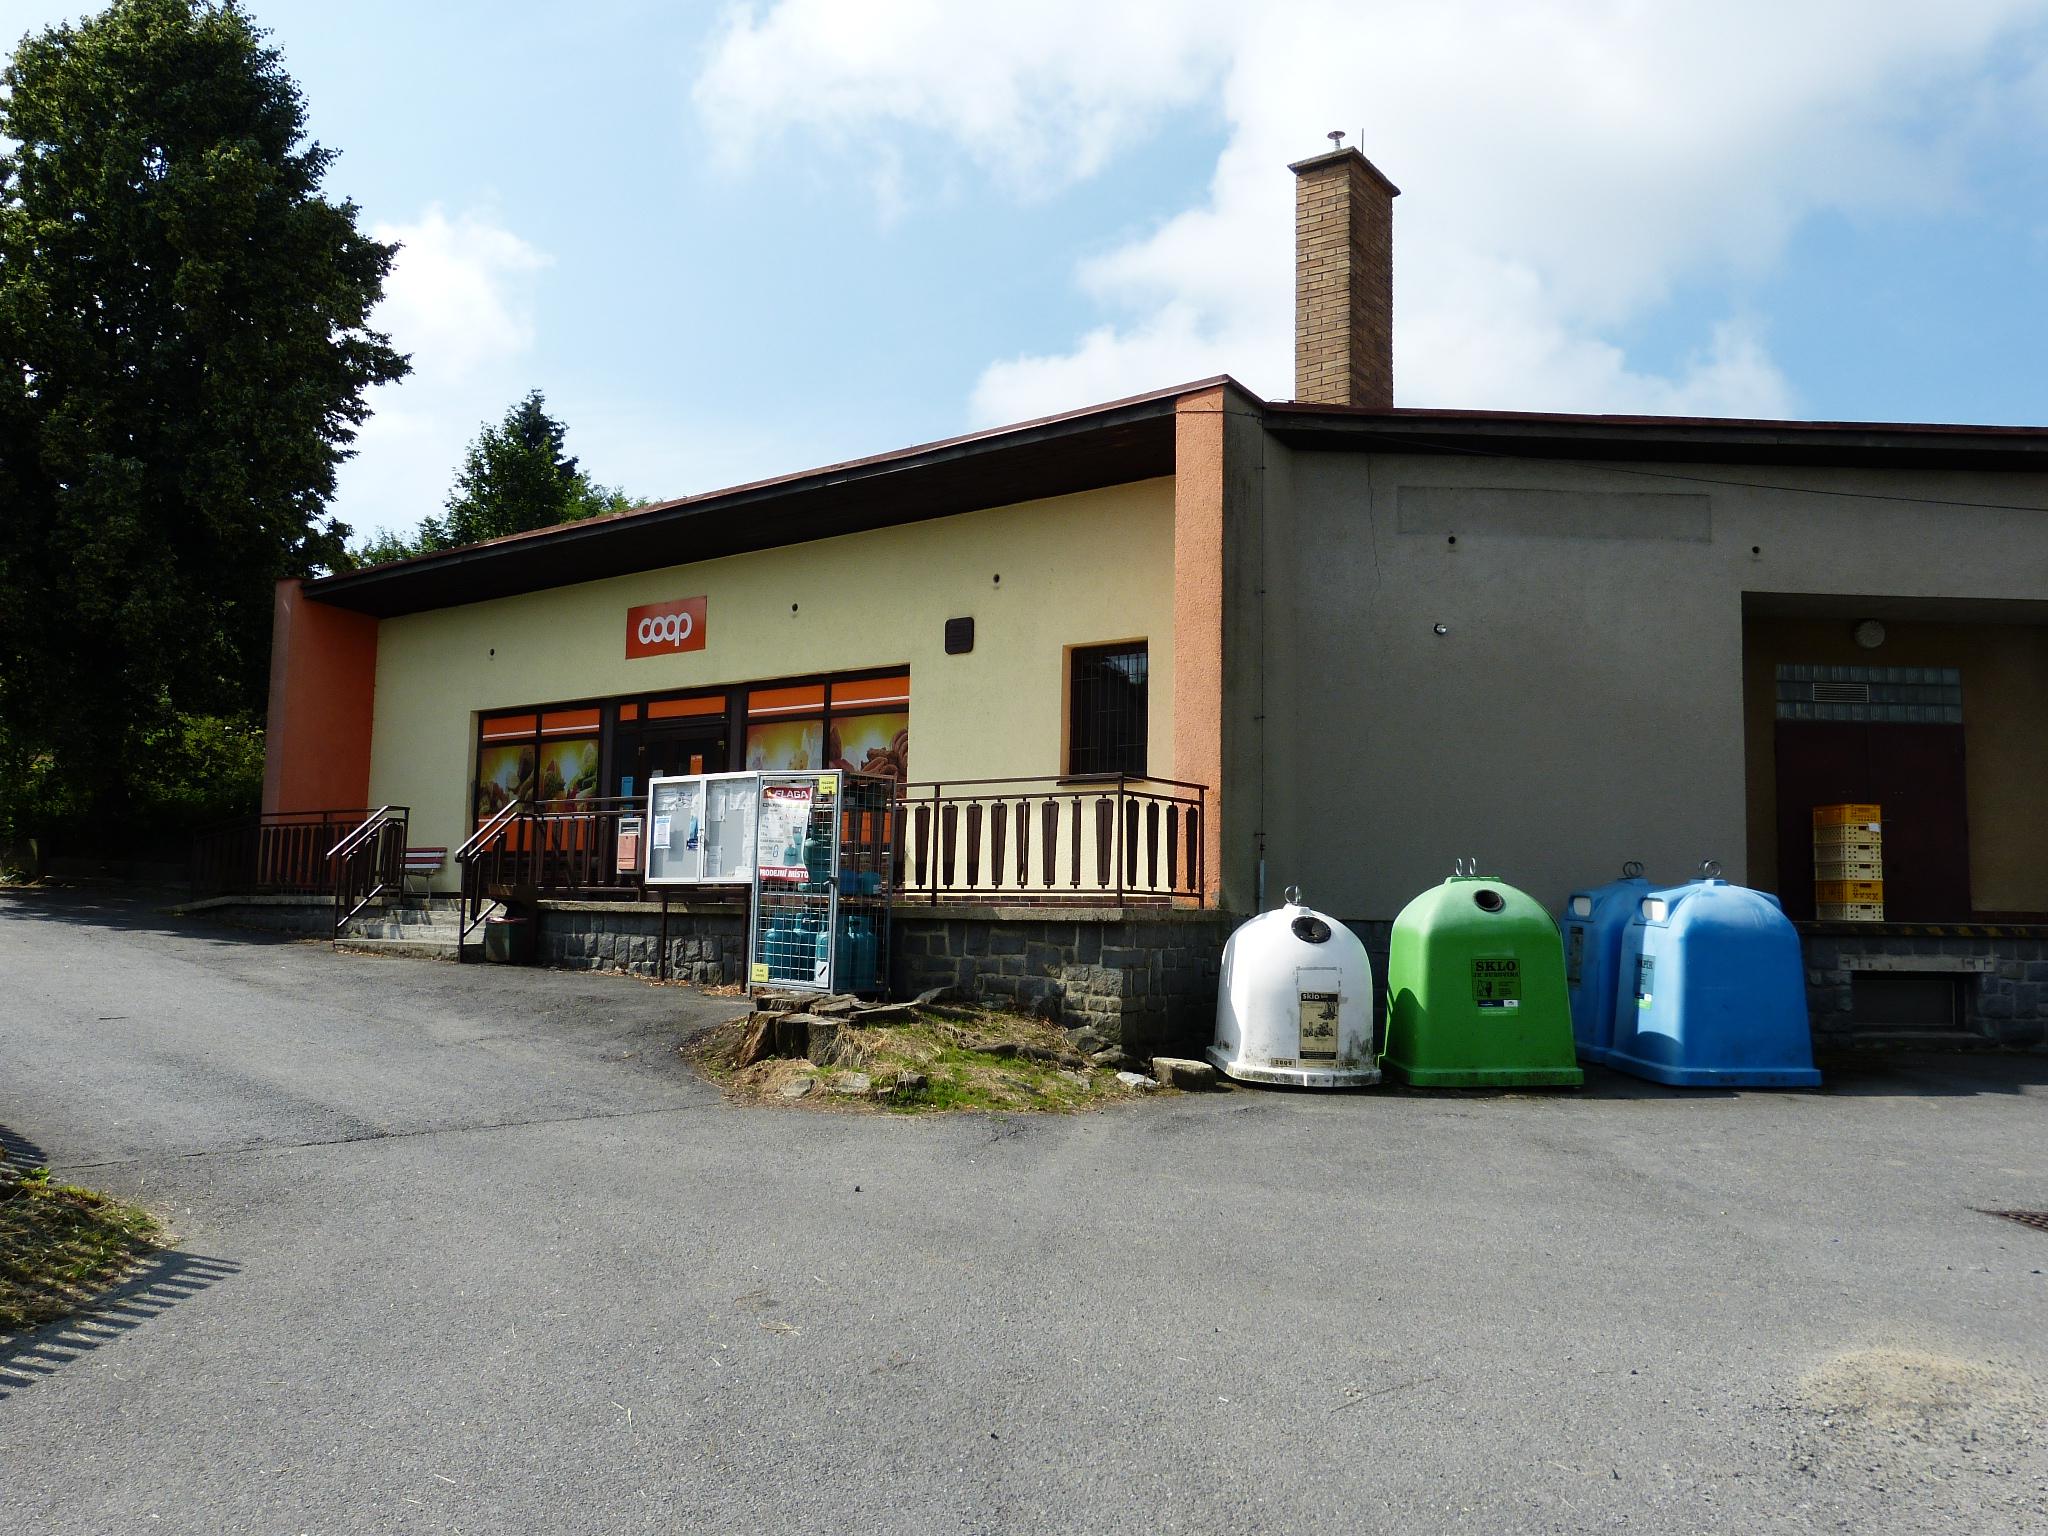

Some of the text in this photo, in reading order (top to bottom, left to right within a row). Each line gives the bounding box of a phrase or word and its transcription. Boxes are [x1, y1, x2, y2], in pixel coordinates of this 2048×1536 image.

[638, 612, 692, 646] coop
[775, 789, 809, 799] FLAGA
[1475, 961, 1516, 971] SKLO
